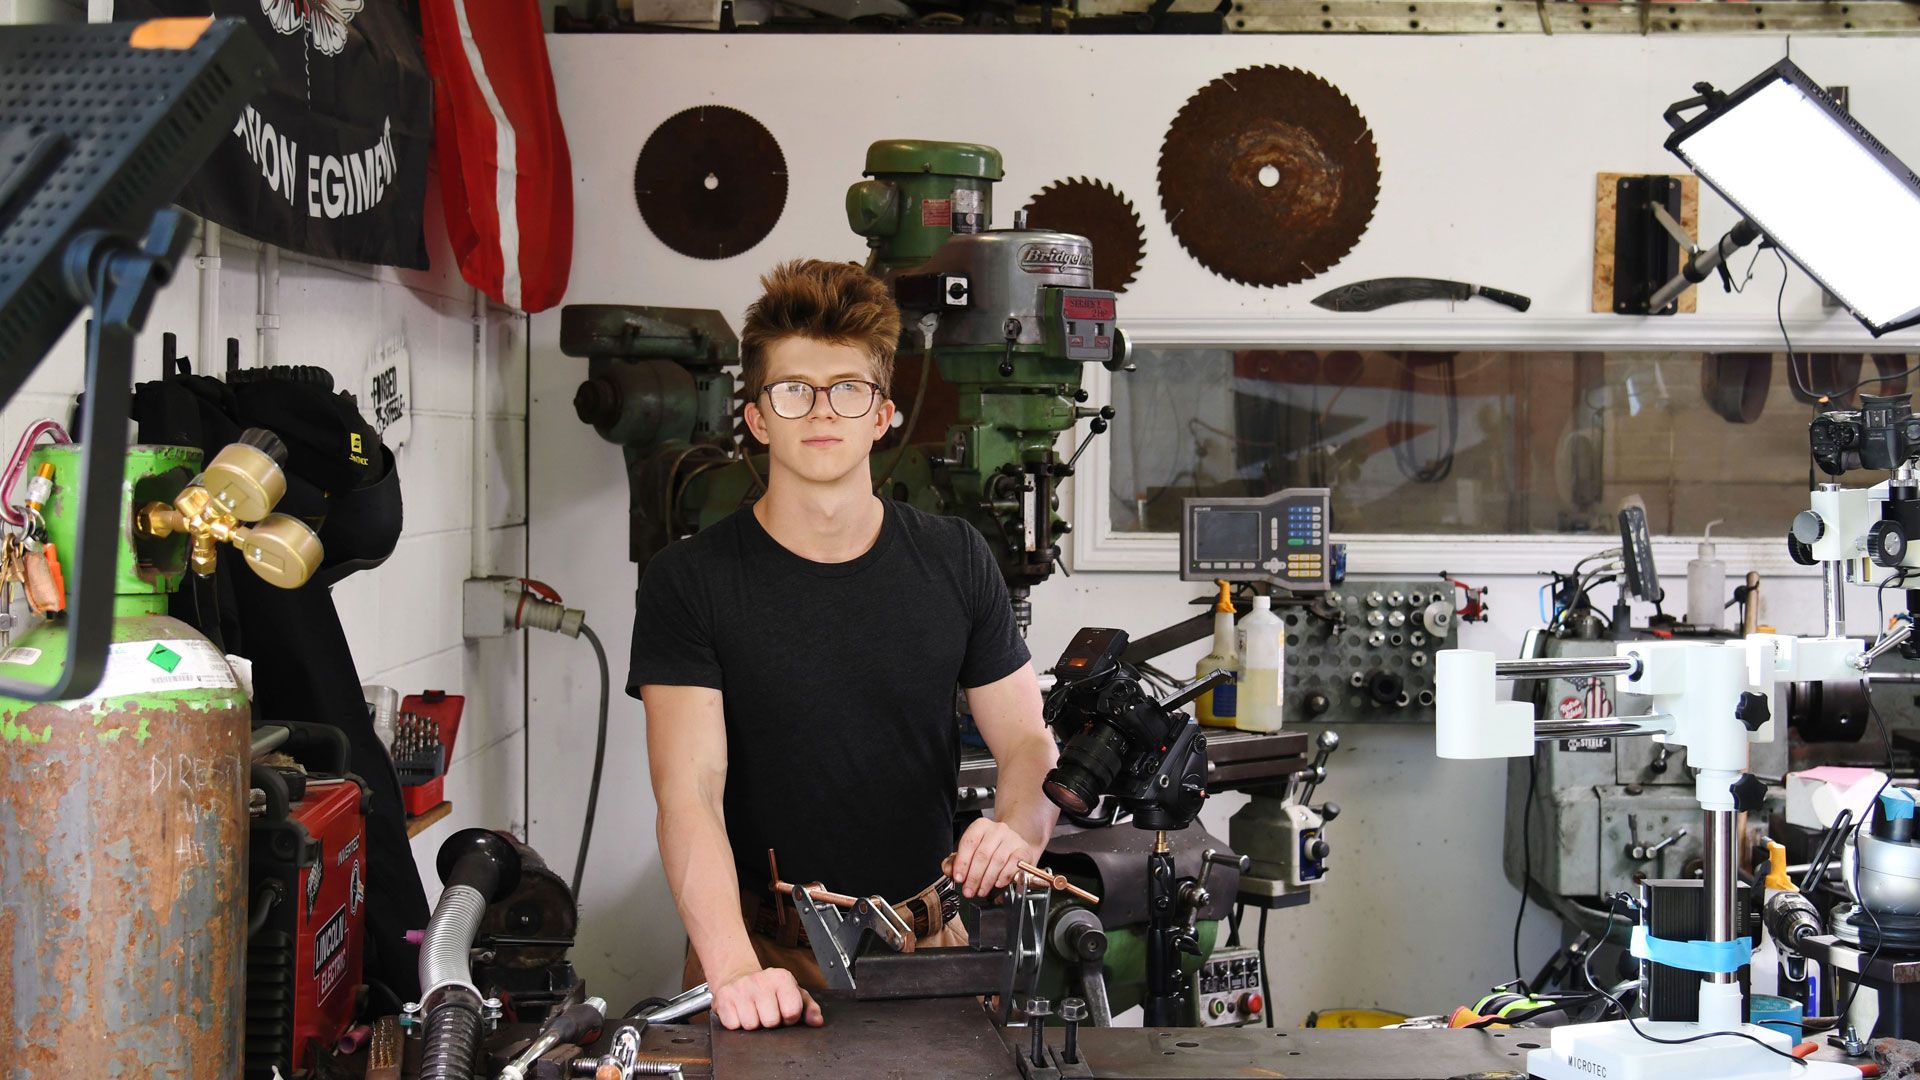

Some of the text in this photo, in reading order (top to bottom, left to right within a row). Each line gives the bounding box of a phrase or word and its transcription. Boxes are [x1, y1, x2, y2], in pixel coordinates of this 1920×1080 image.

[307, 115, 397, 219] EGIMENT
[315, 913, 345, 971] LINCOLN
[321, 948, 346, 994] ELECTRIC
[1567, 1055, 1607, 1078] MICROTEC
